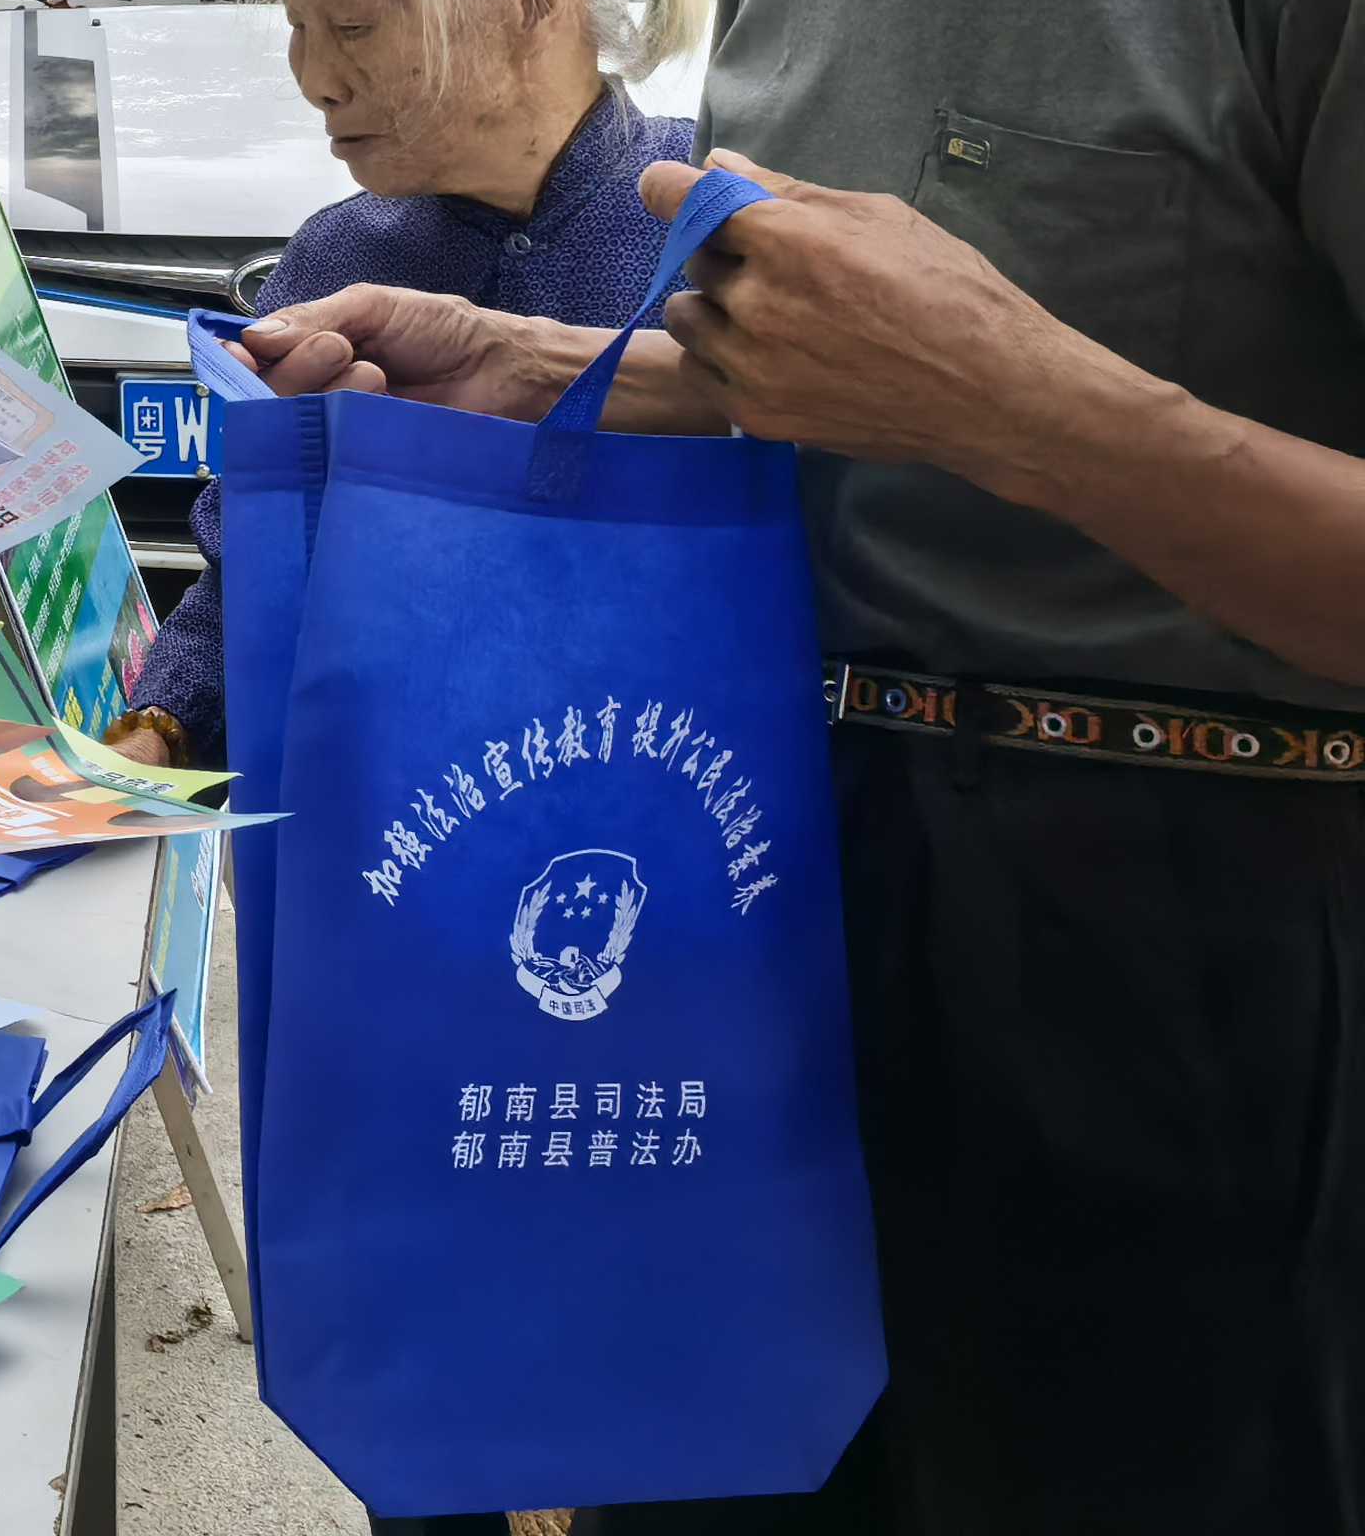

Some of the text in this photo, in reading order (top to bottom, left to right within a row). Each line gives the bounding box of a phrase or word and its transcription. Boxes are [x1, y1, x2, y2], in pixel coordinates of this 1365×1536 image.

[362, 695, 780, 916] 加强法治宣传教育 提升公民法治素养
[548, 997, 597, 1018] 中国司法
[458, 1080, 707, 1122] 郁南县司法局
[451, 1128, 702, 1171] 郁南县普法办
